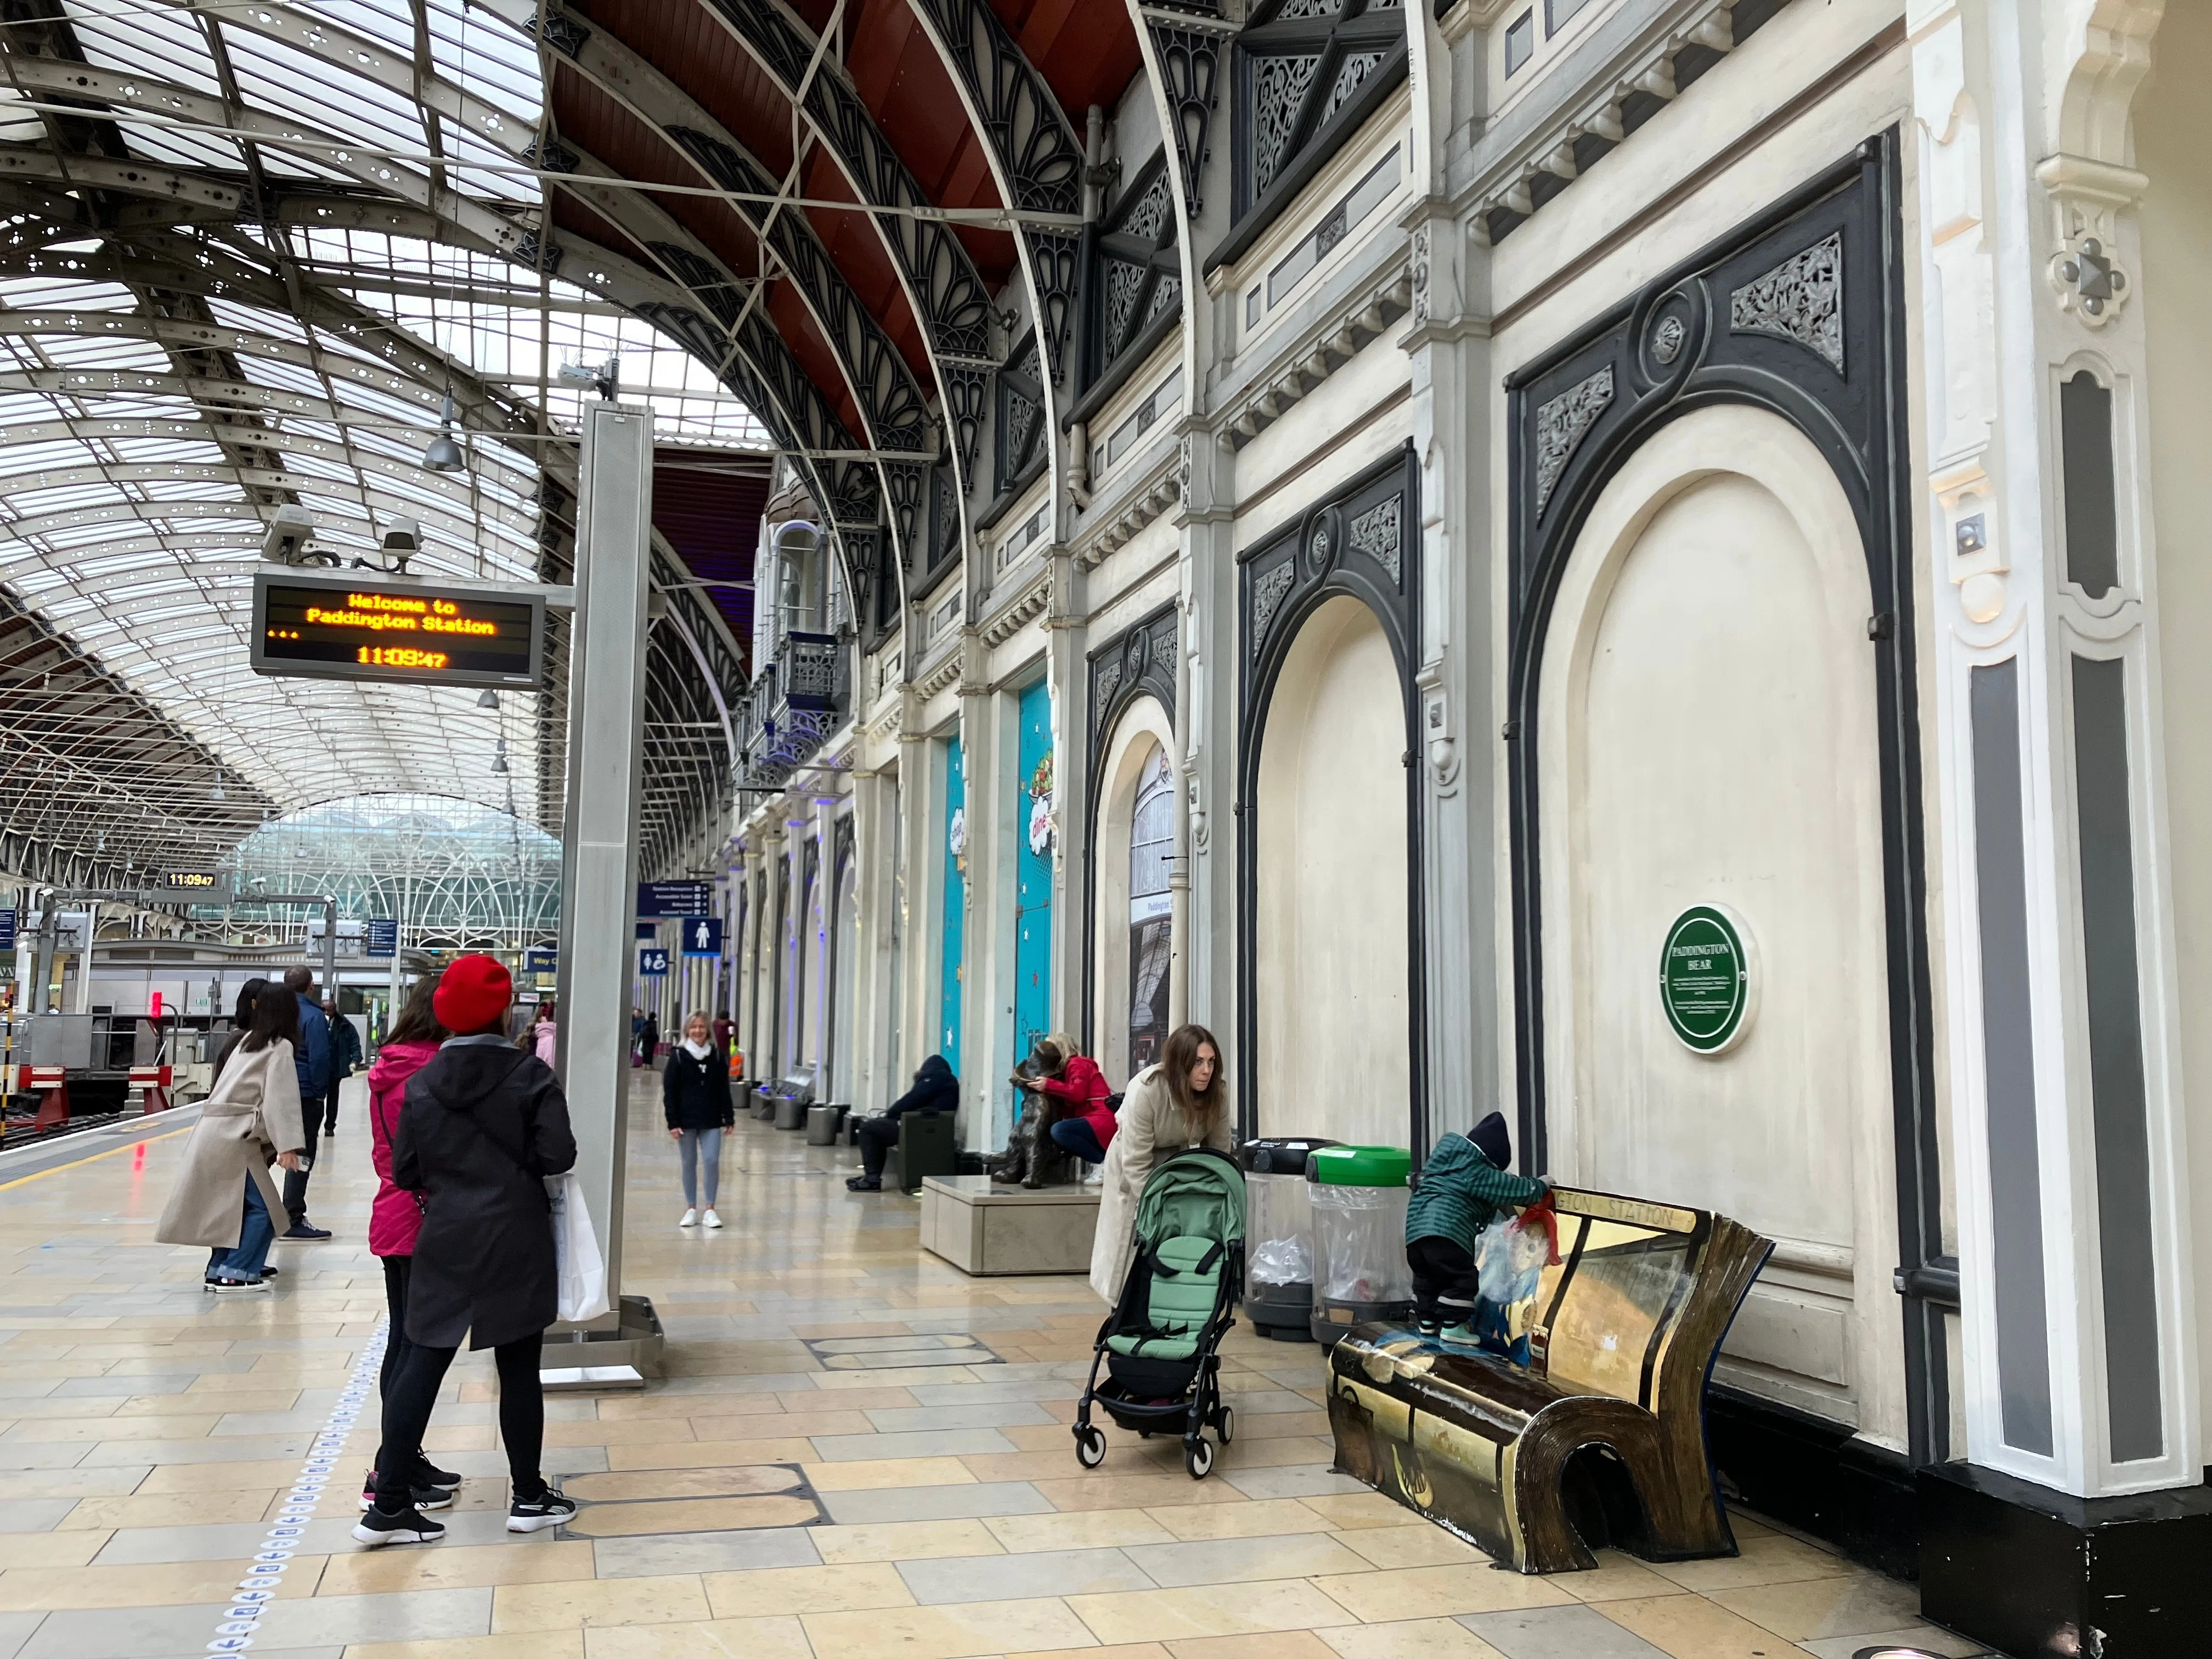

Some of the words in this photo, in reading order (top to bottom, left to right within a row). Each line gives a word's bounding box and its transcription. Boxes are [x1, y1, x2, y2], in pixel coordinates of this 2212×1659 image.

[348, 594, 426, 613] Welcome
[433, 599, 456, 615] to
[307, 608, 416, 630] Paddington
[422, 616, 495, 635] Station
[357, 646, 447, 669] 11:09:47
[1032, 814, 1047, 839] dine
[1148, 901, 1170, 912] Paddington
[1672, 944, 1729, 957] PADDINGTON
[534, 957, 550, 966] Way
[1688, 960, 1712, 970] BEAR
[1607, 1199, 1674, 1227] STATION
